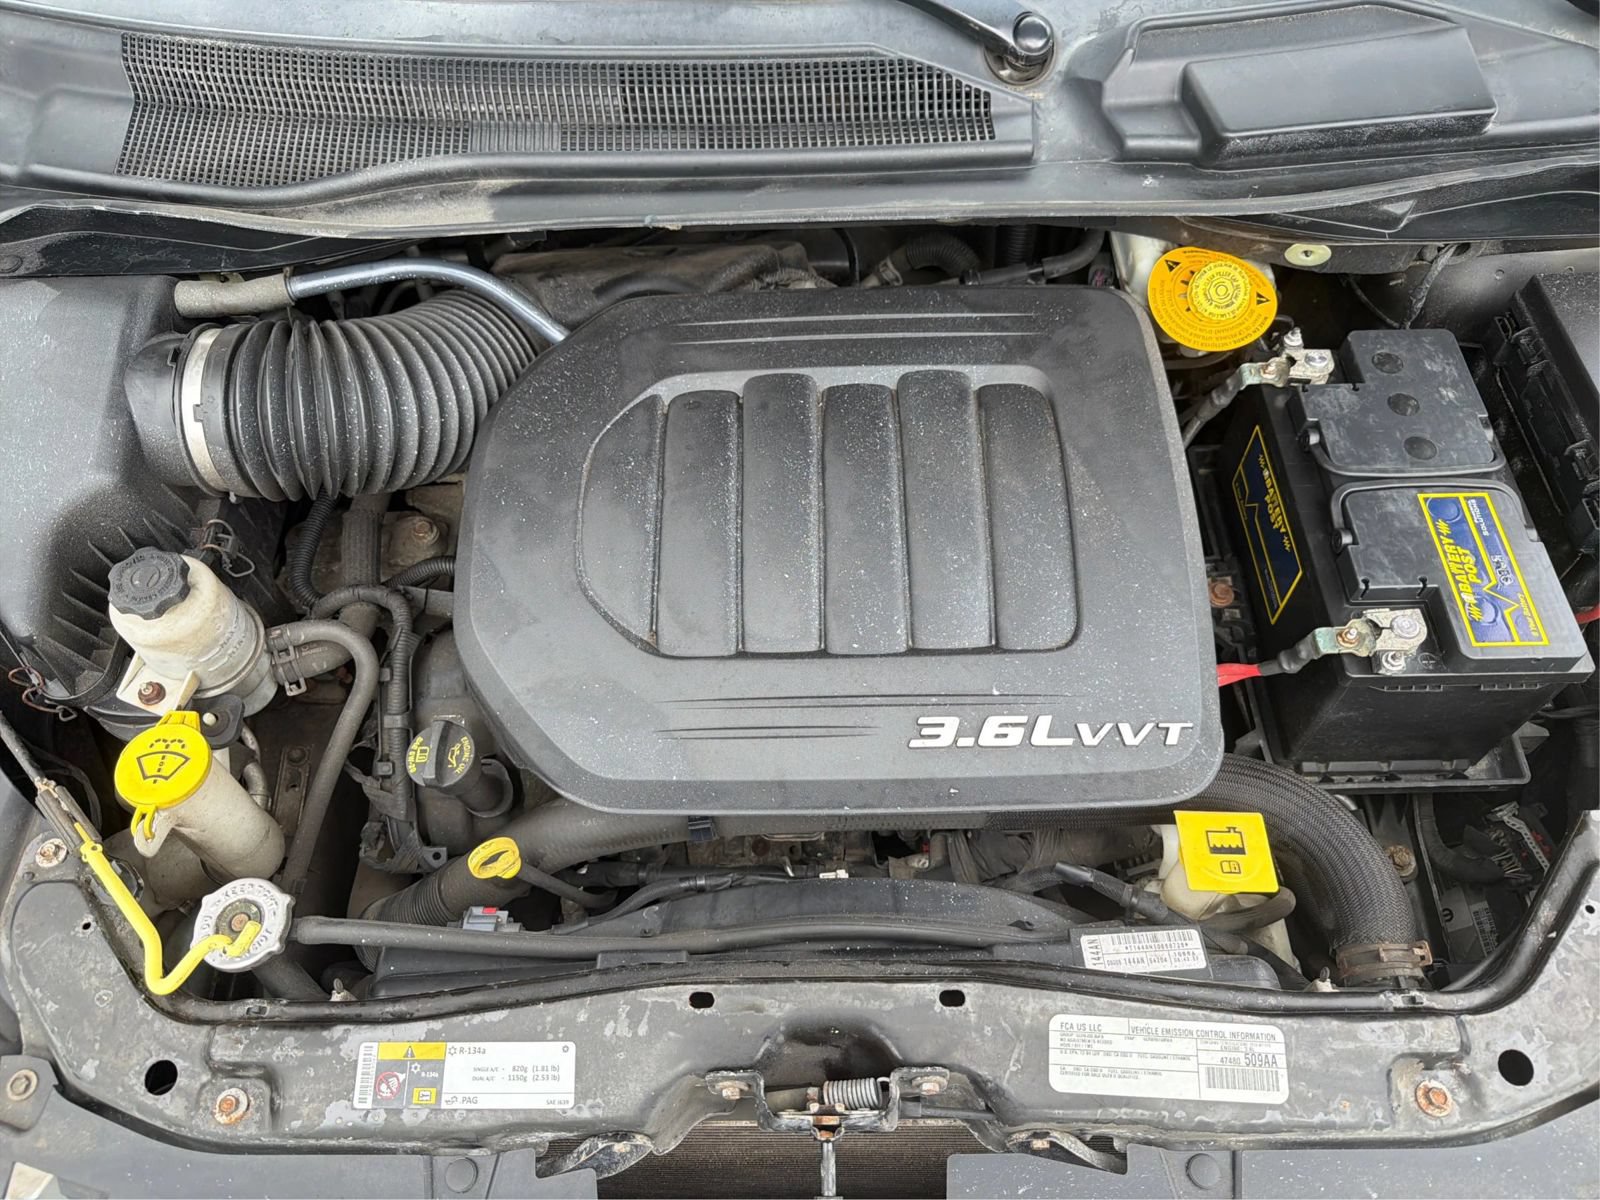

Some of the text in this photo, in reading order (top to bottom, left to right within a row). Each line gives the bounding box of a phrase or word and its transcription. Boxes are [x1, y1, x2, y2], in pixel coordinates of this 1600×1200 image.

[1442, 535, 1473, 596] BATTERY
[1458, 546, 1482, 584] POST
[908, 715, 1194, 749] 3.6L VVT
[454, 736, 471, 775] ENGINE OIL
[1087, 938, 1104, 966] 144AN
[1060, 1022, 1102, 1032] FCA US LLC
[1131, 1025, 1276, 1041] VEHICLE EMISSION CONTROL INFORMATION
[459, 1046, 486, 1055] R-134a
[1244, 1053, 1278, 1067] 509AA
[511, 1065, 528, 1073] 820g
[508, 1074, 528, 1083] 1150g
